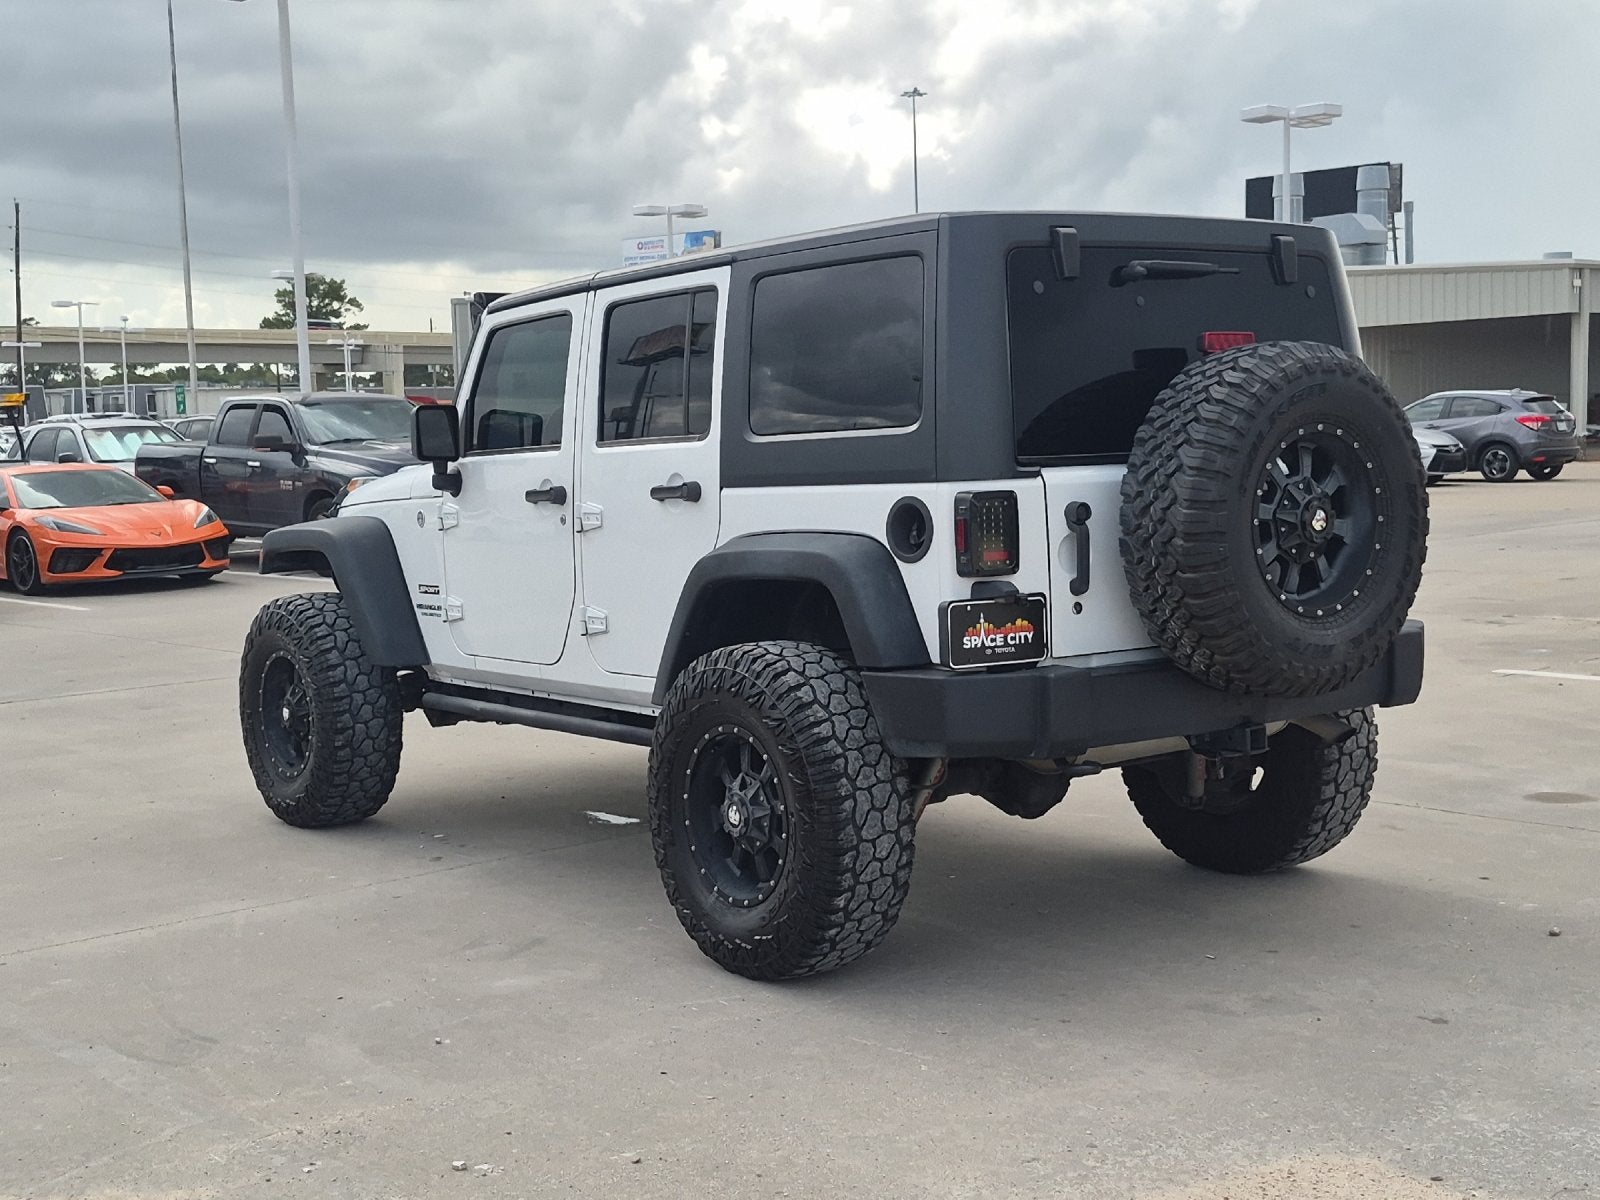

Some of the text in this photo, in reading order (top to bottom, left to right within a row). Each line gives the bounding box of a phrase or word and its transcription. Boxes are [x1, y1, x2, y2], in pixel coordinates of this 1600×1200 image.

[420, 586, 439, 594] SPORT
[963, 632, 1034, 649] SPACE CITY
[994, 646, 1016, 654] TOYOTA
